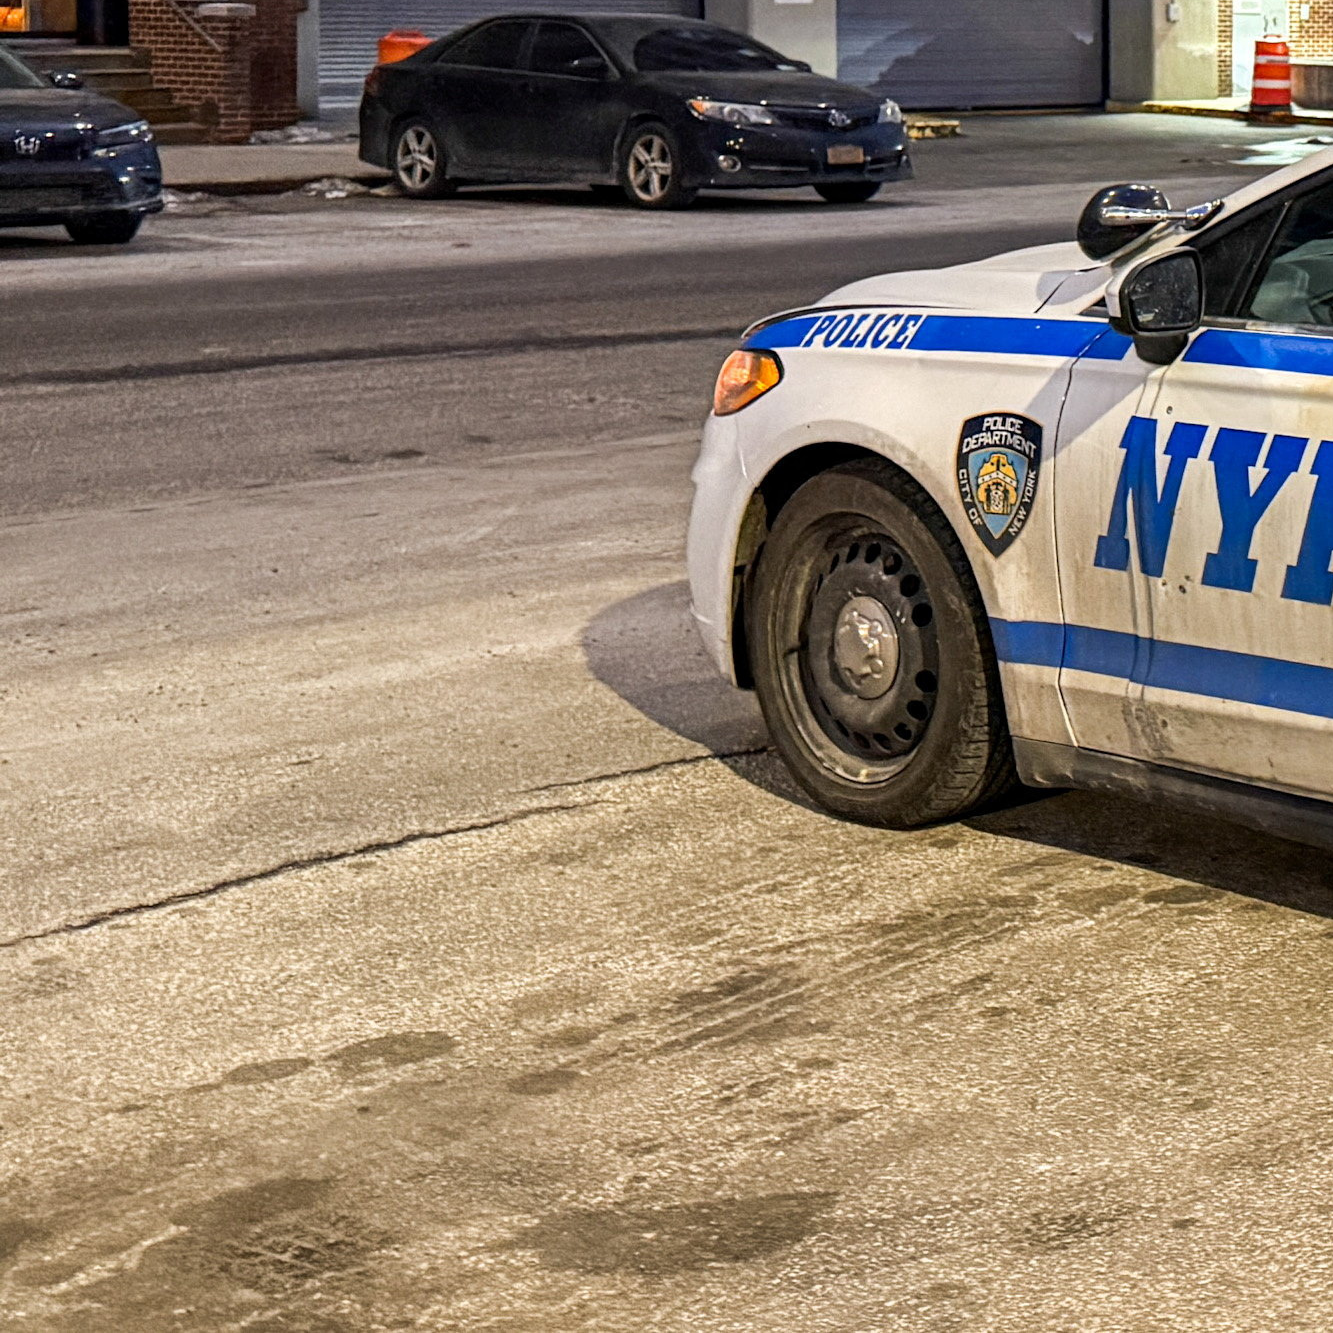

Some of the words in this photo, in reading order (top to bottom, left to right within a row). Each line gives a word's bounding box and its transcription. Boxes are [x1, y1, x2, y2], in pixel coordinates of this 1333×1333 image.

[802, 313, 924, 349] POLICE
[982, 416, 1024, 434] POLICE
[962, 431, 1037, 459] DEPARTMENT
[958, 468, 973, 503] CITY
[968, 508, 983, 526] OF
[1008, 507, 1028, 536] NEW
[1023, 469, 1037, 504] YORK
